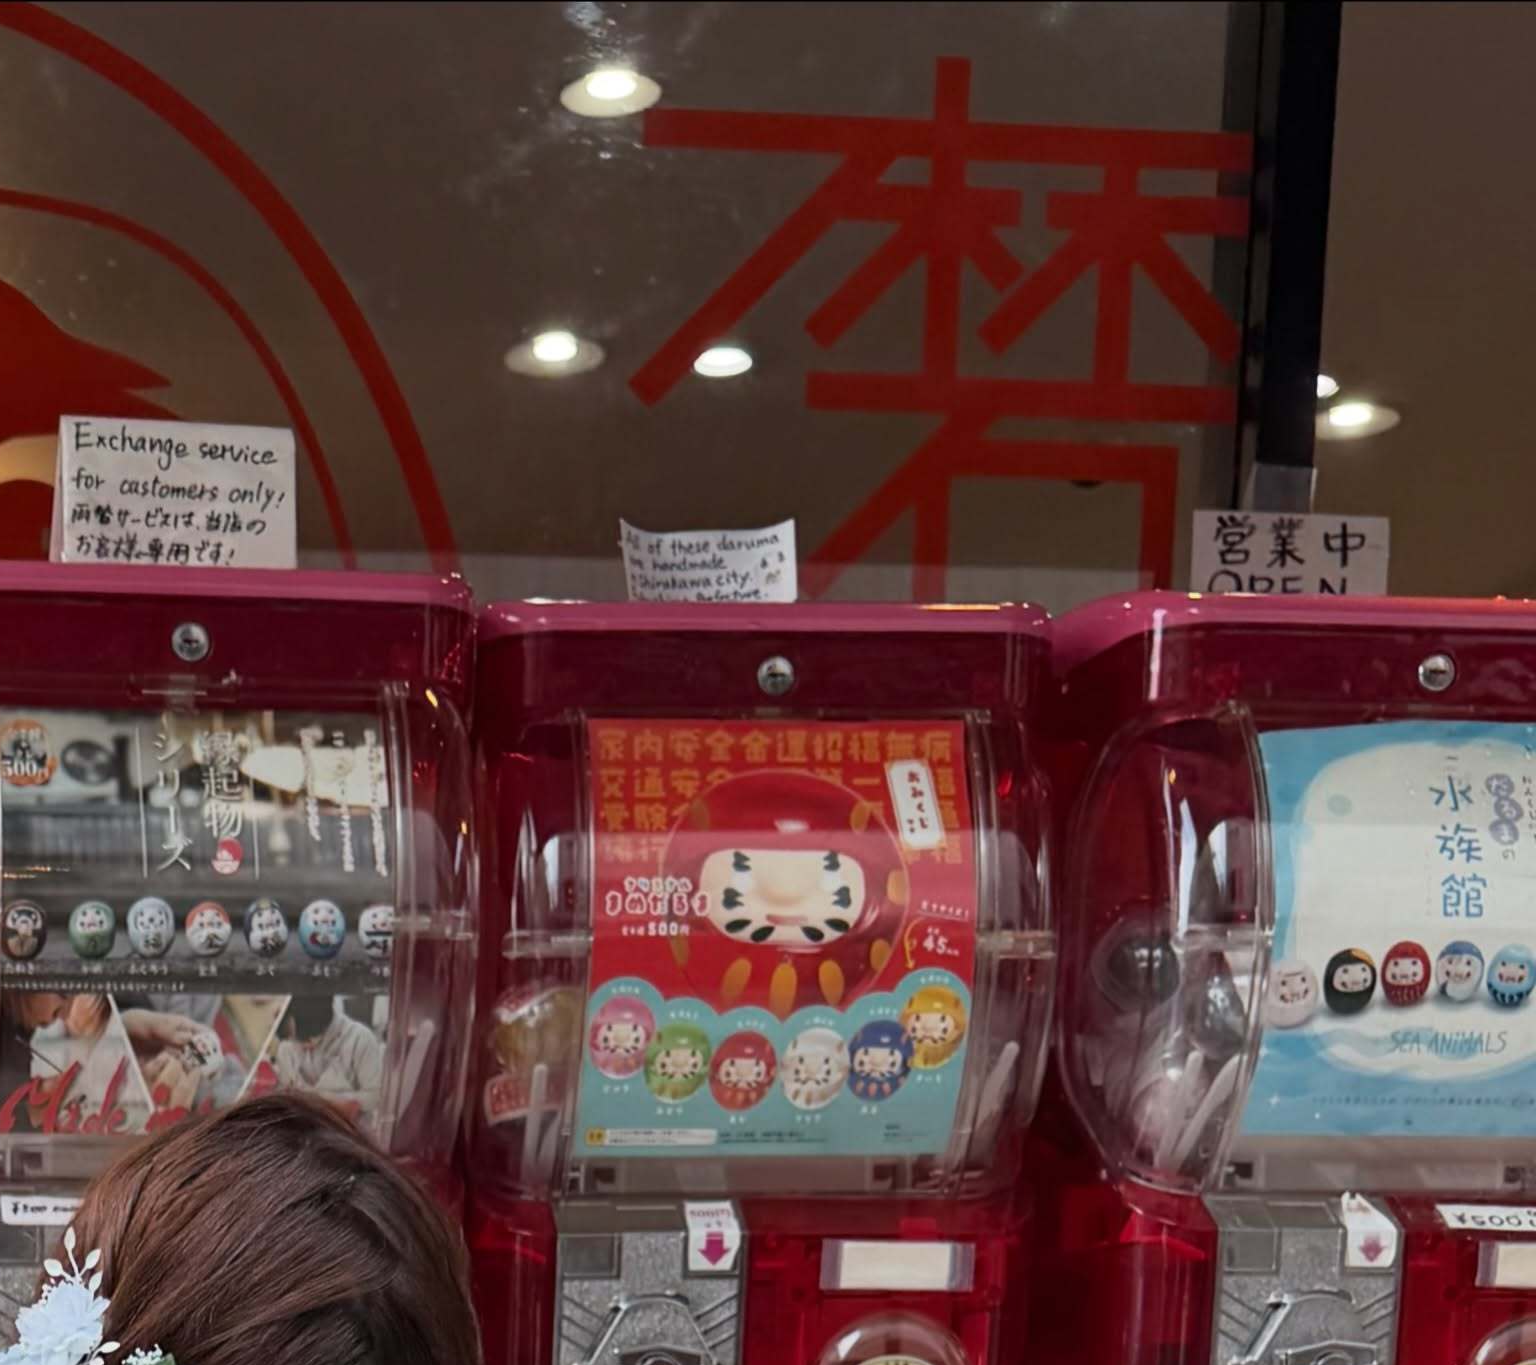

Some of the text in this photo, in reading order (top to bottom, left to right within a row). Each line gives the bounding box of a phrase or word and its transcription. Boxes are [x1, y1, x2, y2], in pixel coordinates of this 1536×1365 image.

[73, 421, 279, 471] Exchange service
[70, 467, 106, 491] for
[227, 481, 287, 513] only!
[1214, 515, 1366, 568] 営業中
[1428, 775, 1488, 918] 水族館
